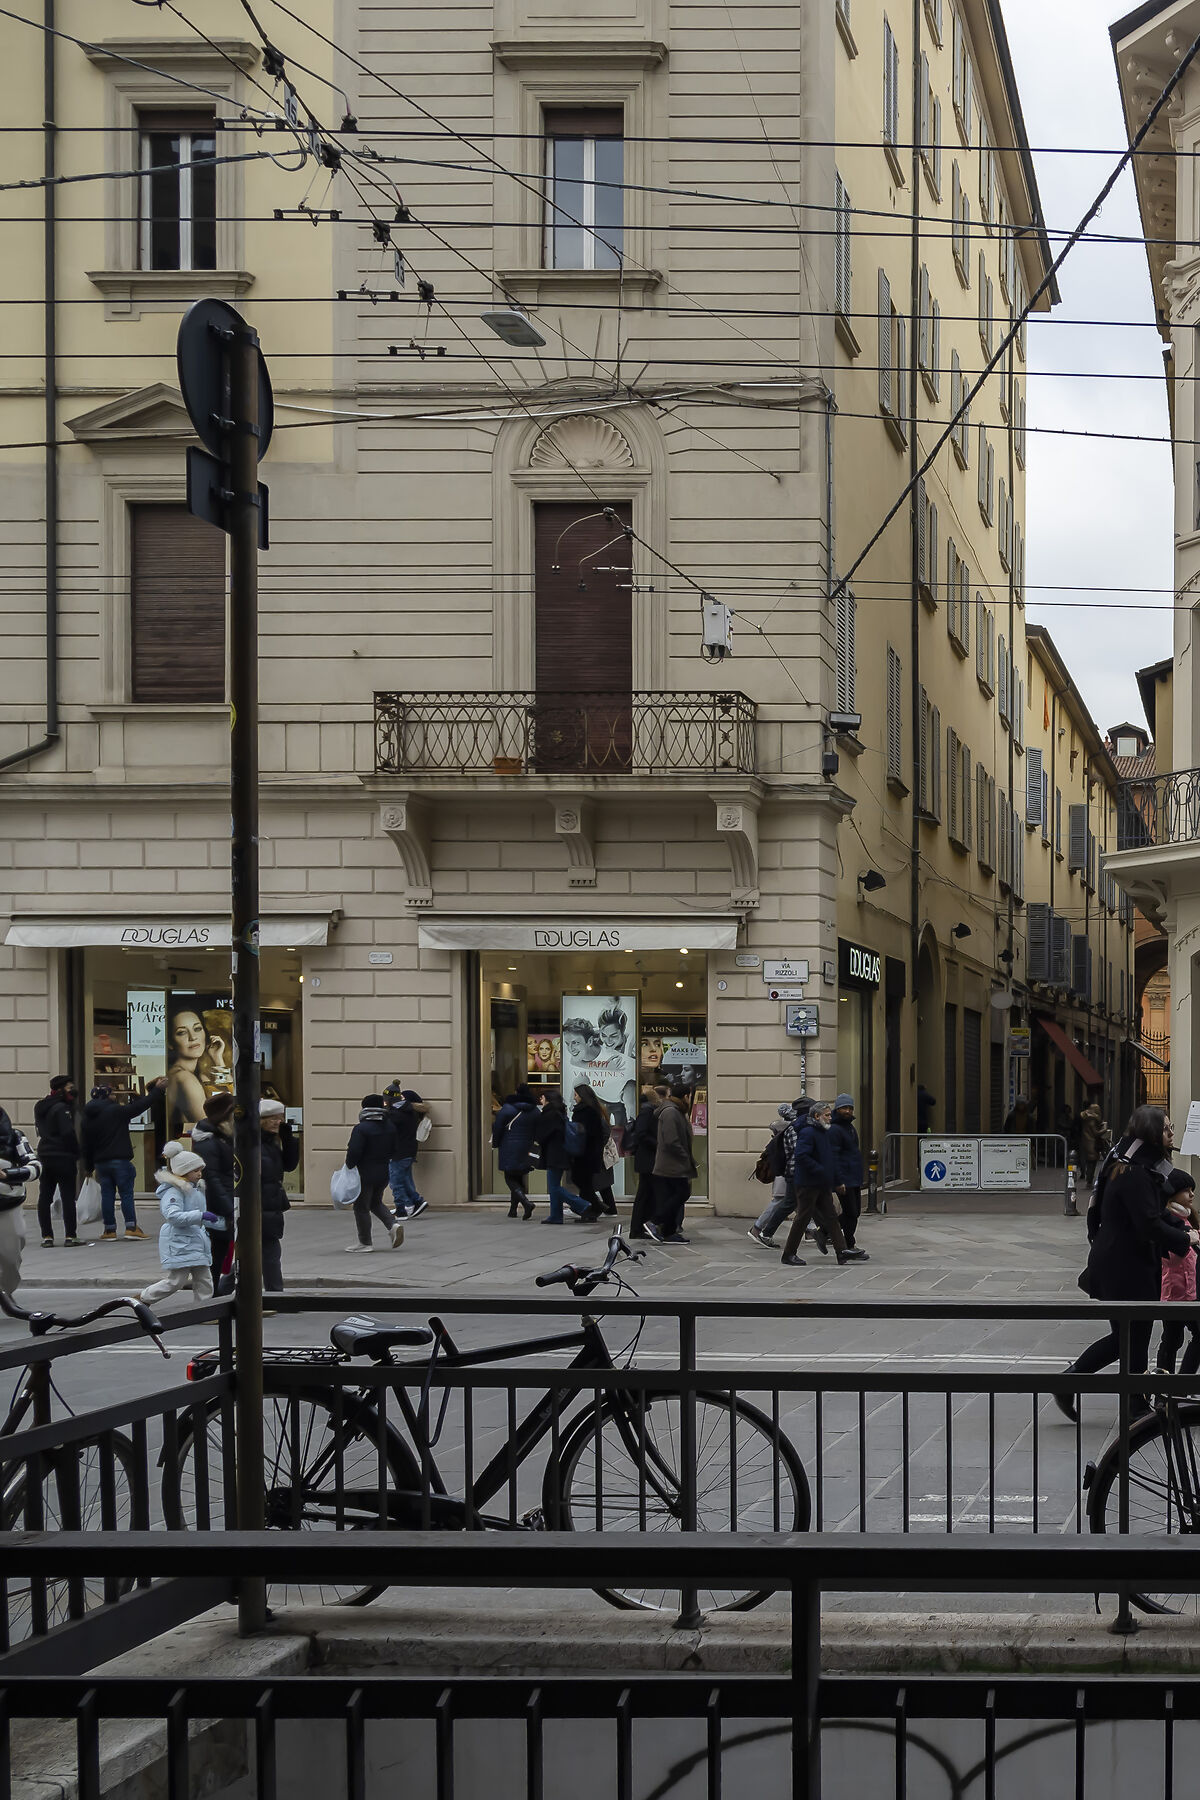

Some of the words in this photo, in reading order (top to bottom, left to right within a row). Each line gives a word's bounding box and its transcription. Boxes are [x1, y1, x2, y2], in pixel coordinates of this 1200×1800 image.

[120, 928, 210, 944] DOUGLAS
[534, 930, 620, 947] DOUGLAS
[850, 947, 880, 983] DOUGLAS
[130, 1000, 166, 1012] Make
[588, 1060, 610, 1068] HAPPY
[592, 1079, 606, 1087] DAY
